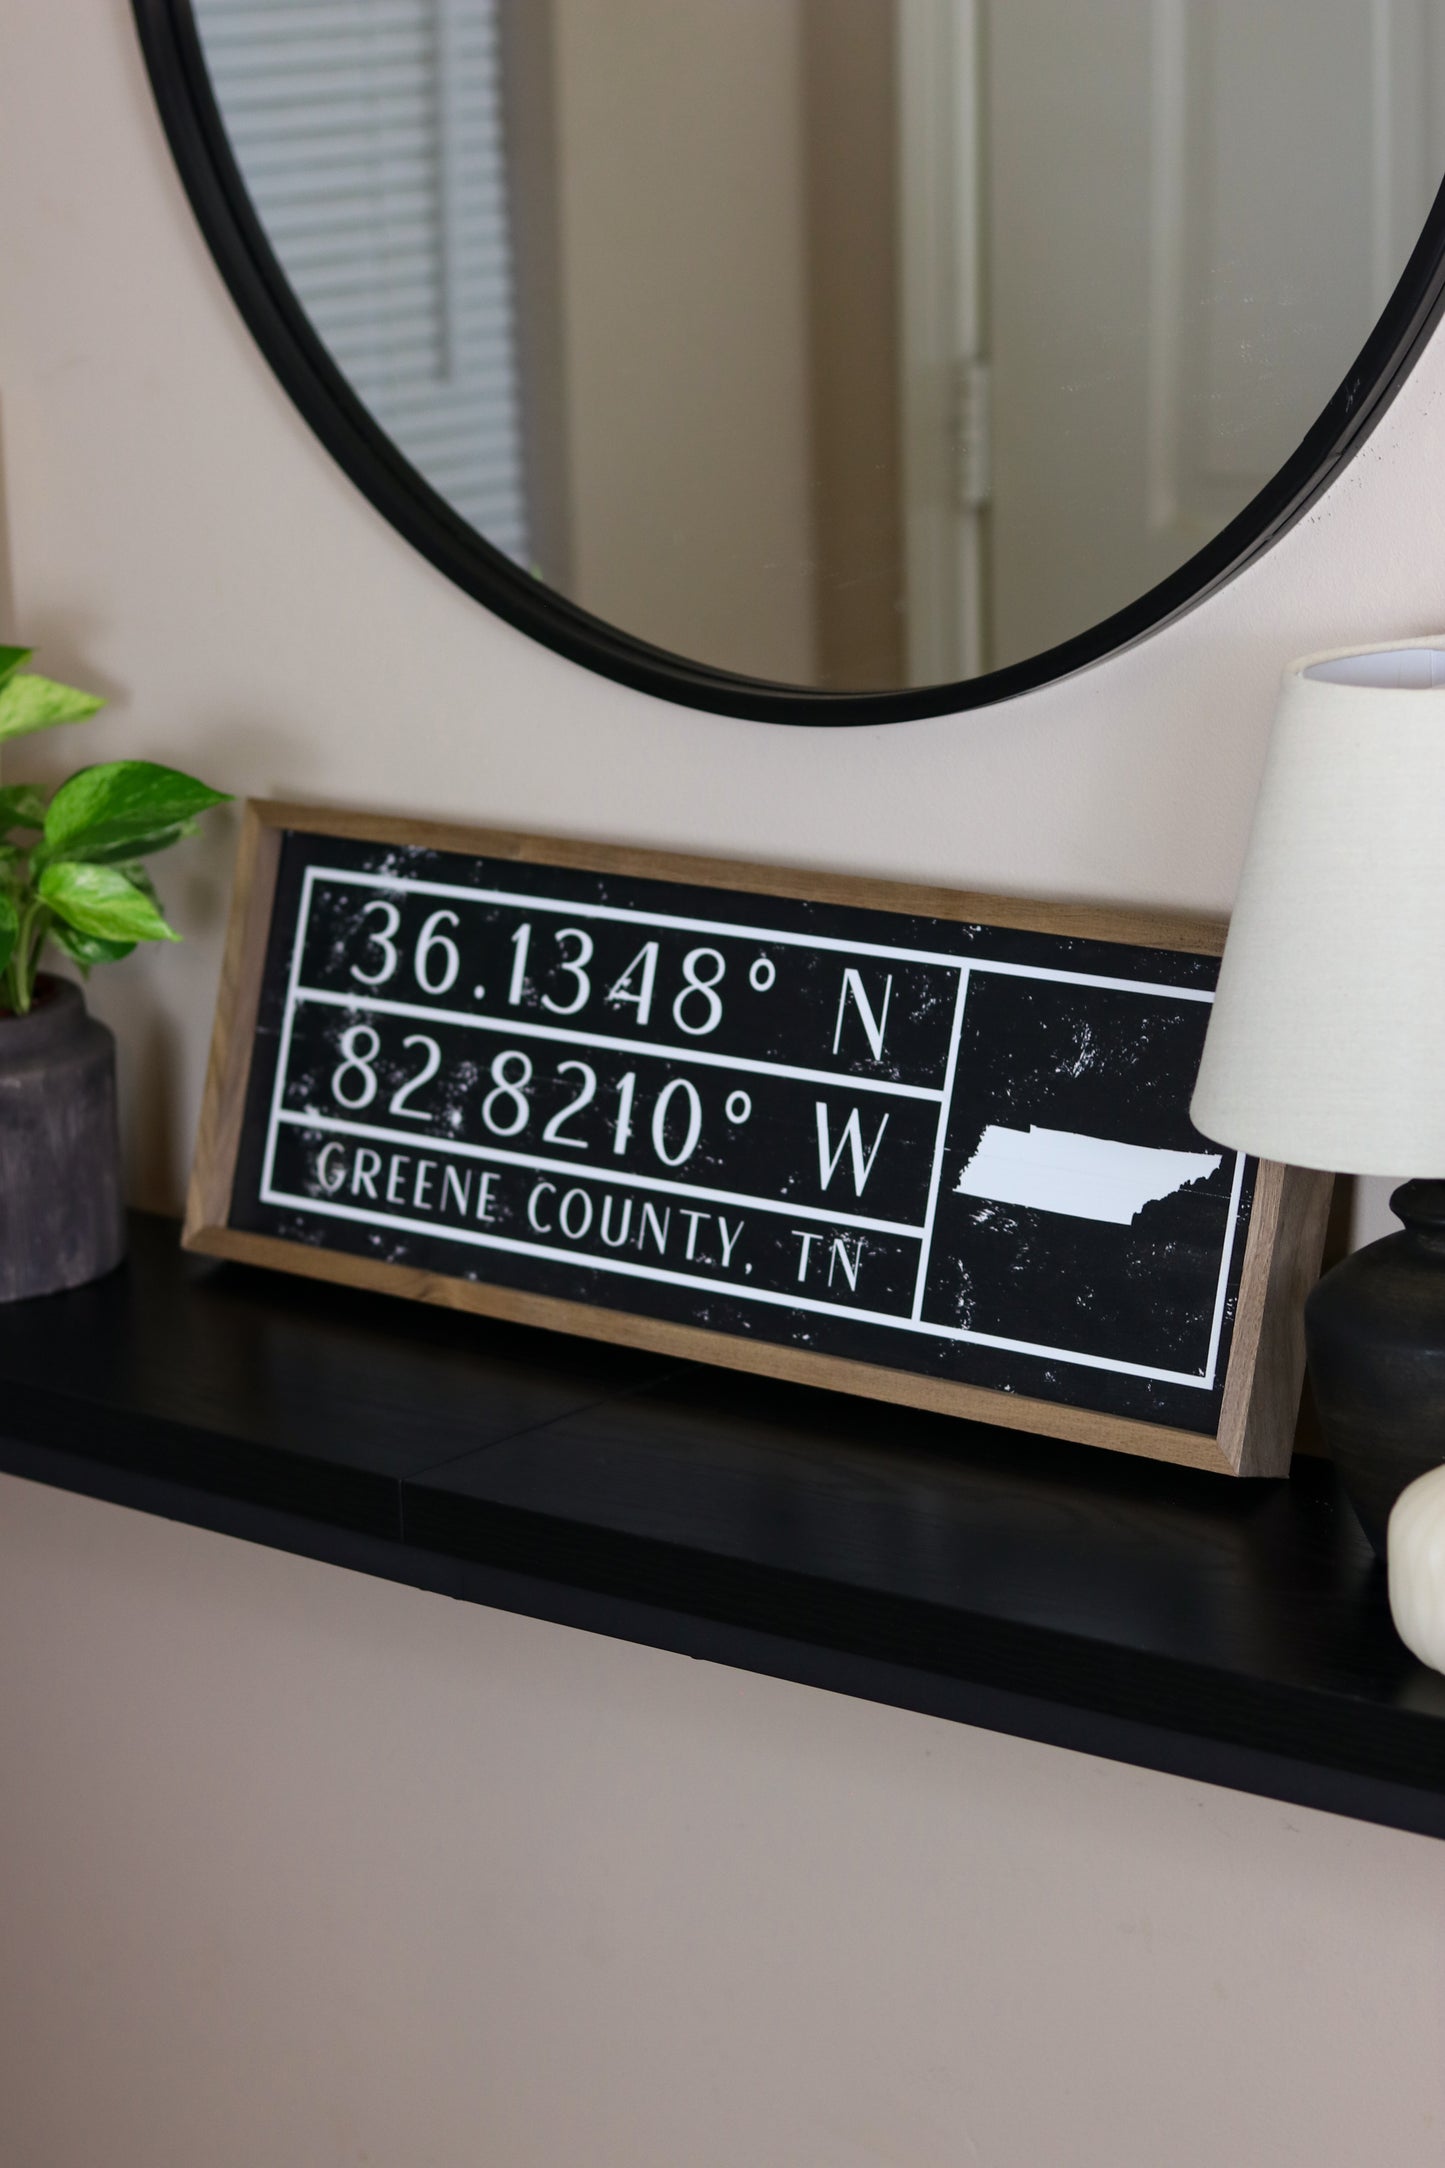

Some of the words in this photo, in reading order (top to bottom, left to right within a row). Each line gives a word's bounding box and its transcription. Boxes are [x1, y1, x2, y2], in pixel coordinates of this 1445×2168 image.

[350, 900, 776, 1036] 36.1348°
[832, 967, 893, 1062] N
[316, 1141, 501, 1223] GREENE
[527, 1181, 753, 1275] COUNTY,
[791, 1229, 863, 1292] TN
[815, 1101, 890, 1197] W
